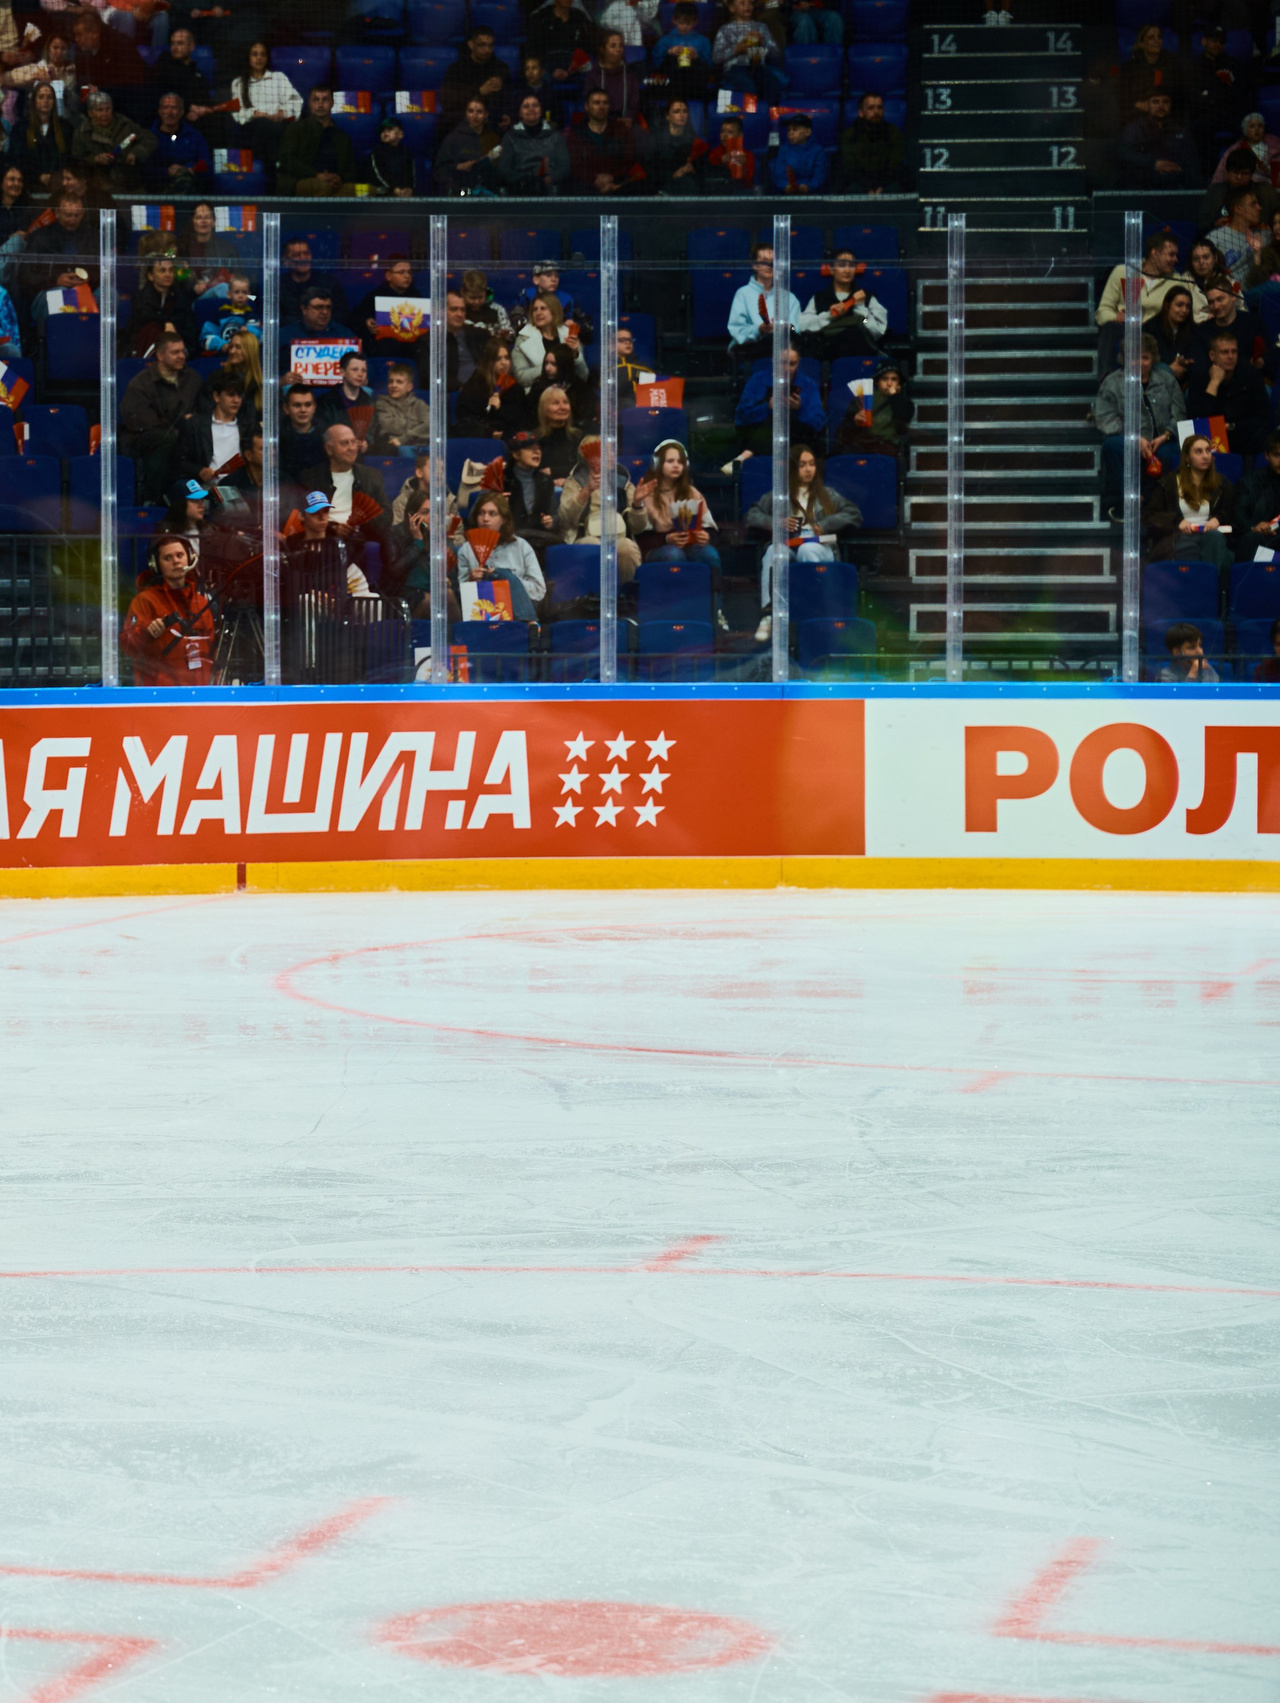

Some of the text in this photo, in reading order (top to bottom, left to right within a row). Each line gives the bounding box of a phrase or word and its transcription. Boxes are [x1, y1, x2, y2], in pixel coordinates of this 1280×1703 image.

[931, 33, 957, 54] 14
[1046, 31, 1073, 53] 14
[925, 88, 952, 110] 13
[1049, 86, 1077, 108] 13
[922, 148, 951, 170] 12
[1049, 145, 1078, 168] 12
[924, 206, 946, 228] 11
[1053, 206, 1075, 230] 11
[109, 731, 531, 837] МАШИНА
